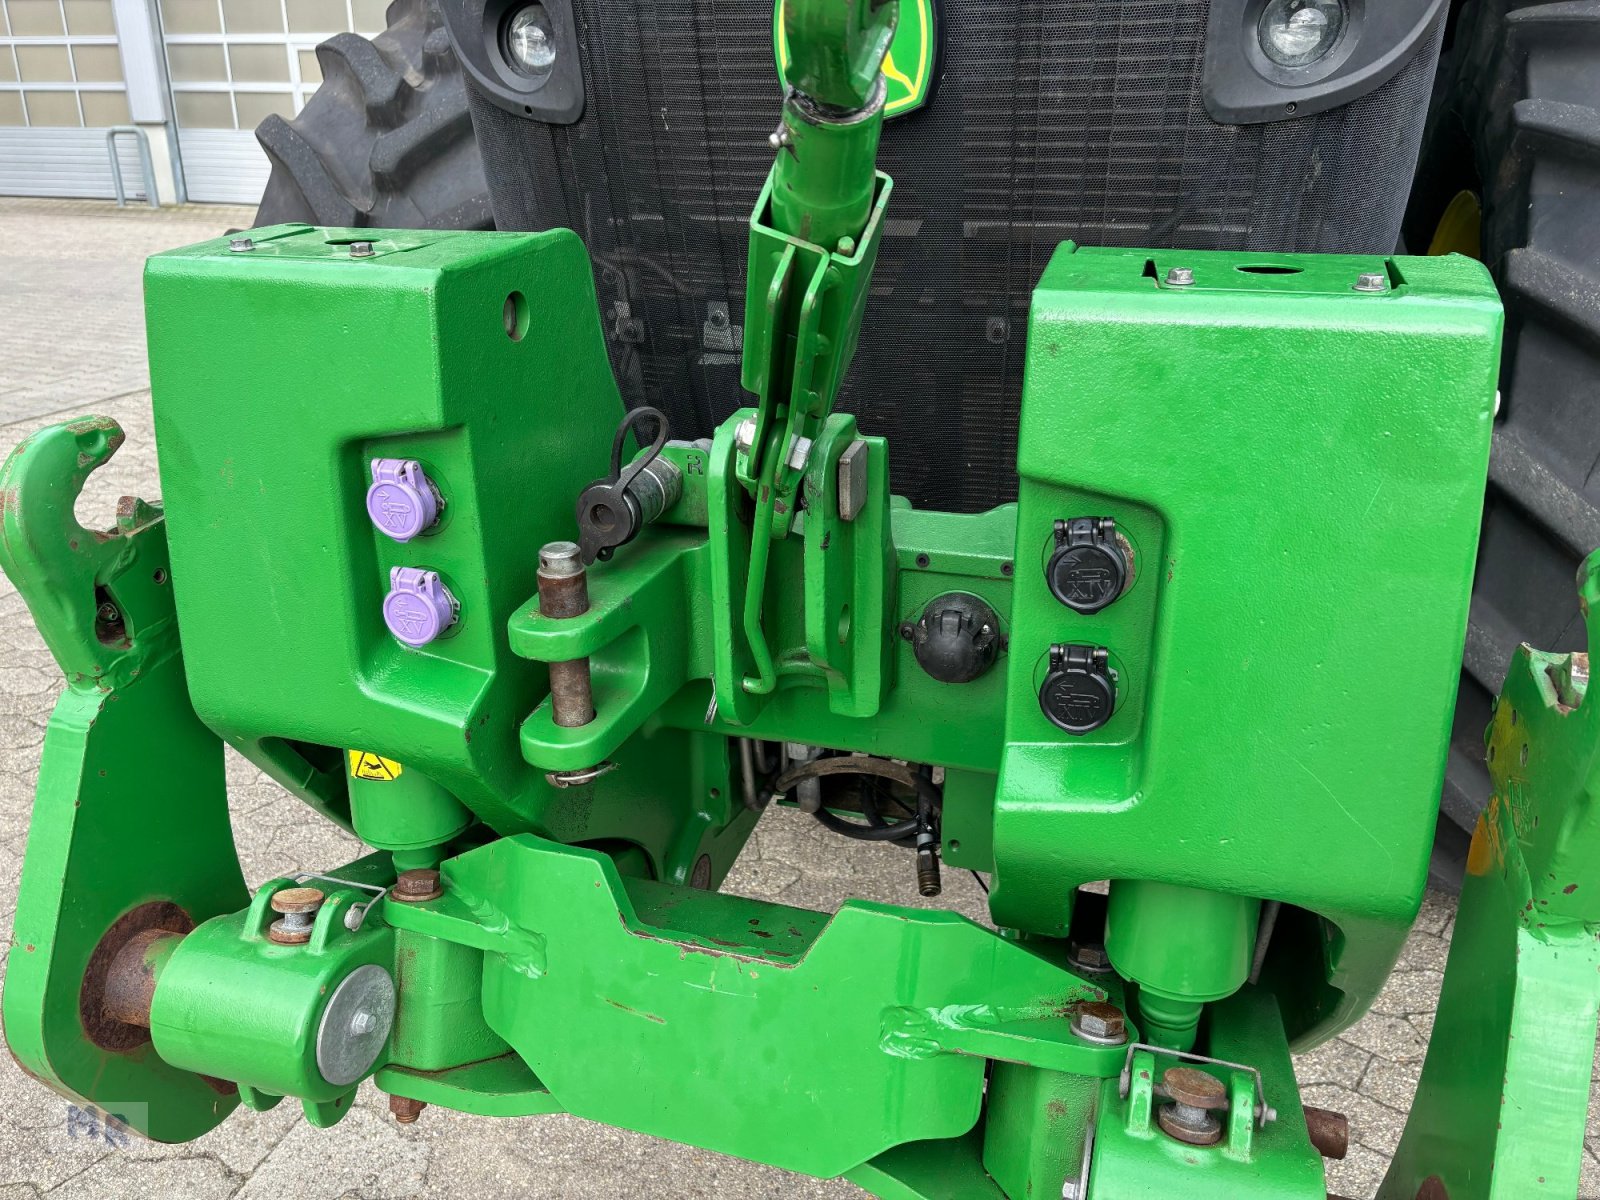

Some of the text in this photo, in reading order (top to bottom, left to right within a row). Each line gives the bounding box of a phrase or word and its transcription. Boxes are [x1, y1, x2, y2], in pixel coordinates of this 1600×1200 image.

[687, 455, 704, 475] R
[383, 511, 408, 528] XV
[399, 618, 424, 635] XV
